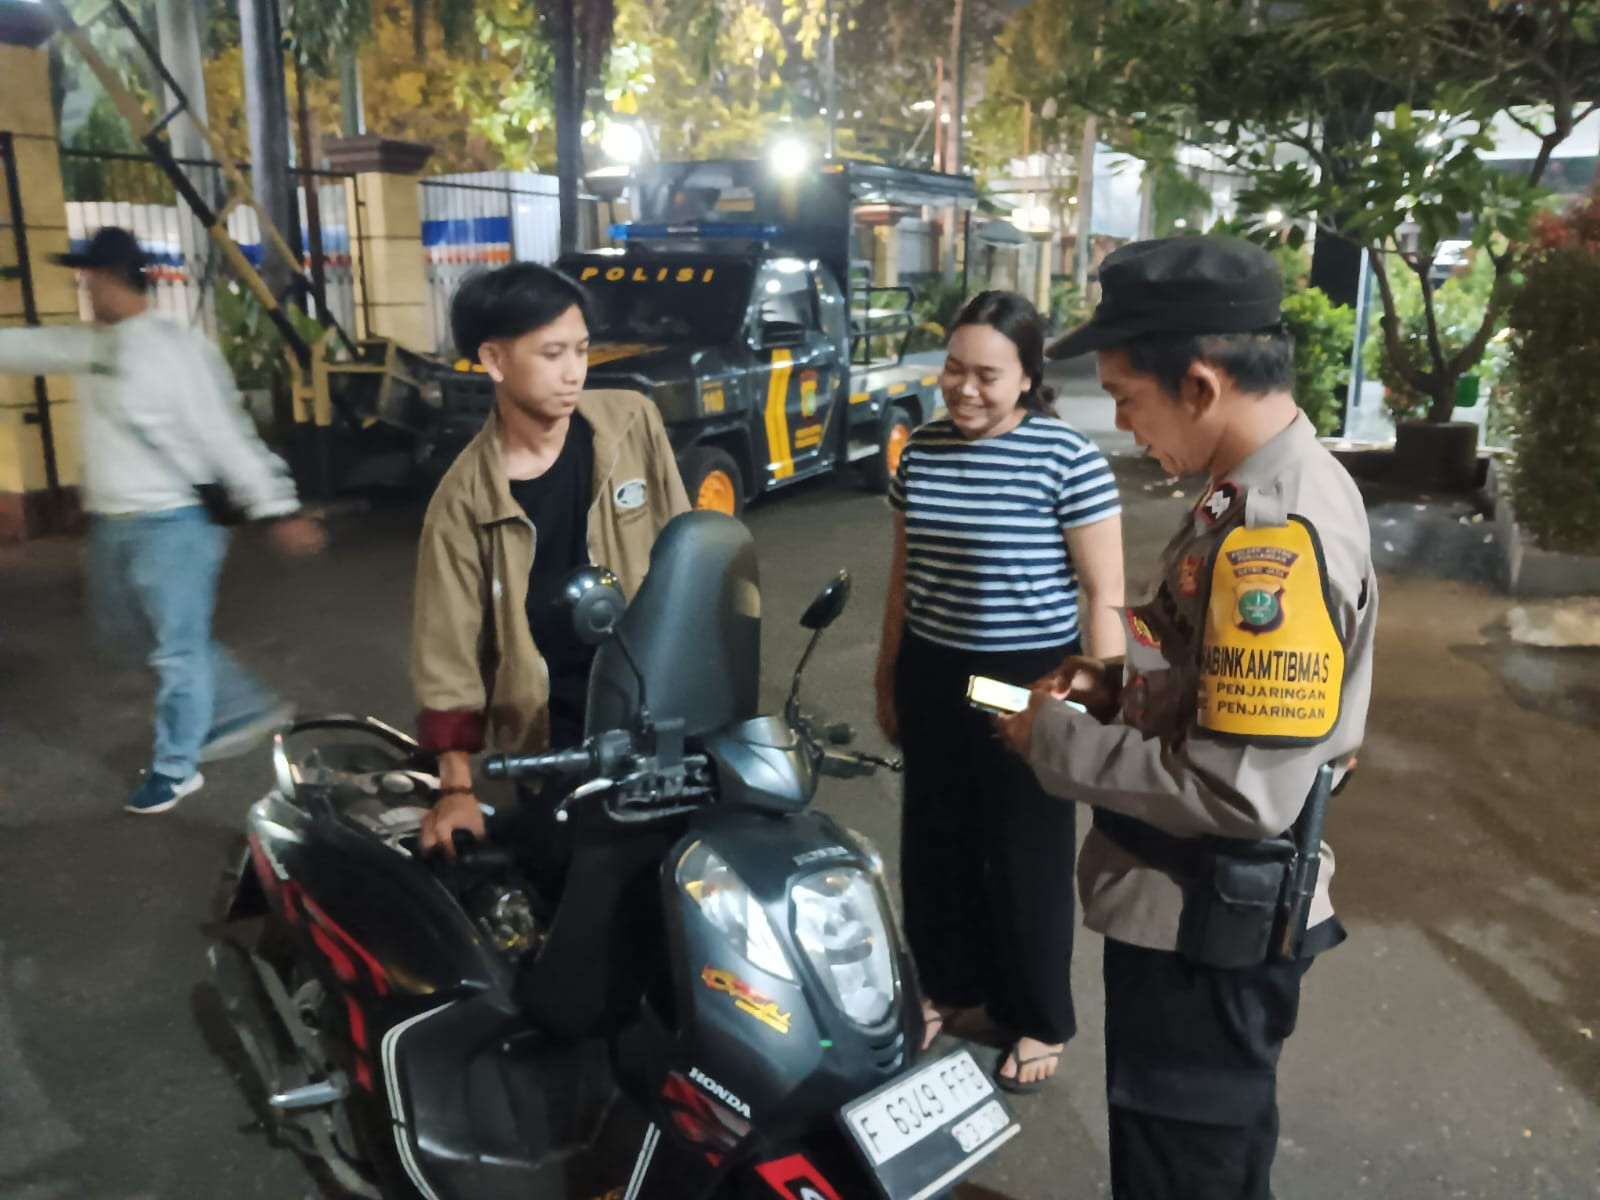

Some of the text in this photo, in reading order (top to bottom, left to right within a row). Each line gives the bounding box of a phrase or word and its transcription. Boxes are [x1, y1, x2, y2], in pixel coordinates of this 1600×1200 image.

[580, 266, 714, 282] POLISI
[1216, 682, 1326, 700] PENJARINGAN
[1217, 701, 1325, 719] PENJARINGAN
[688, 1067, 751, 1119] HONDA
[860, 1116, 881, 1154] F
[886, 1084, 944, 1135] 6349
